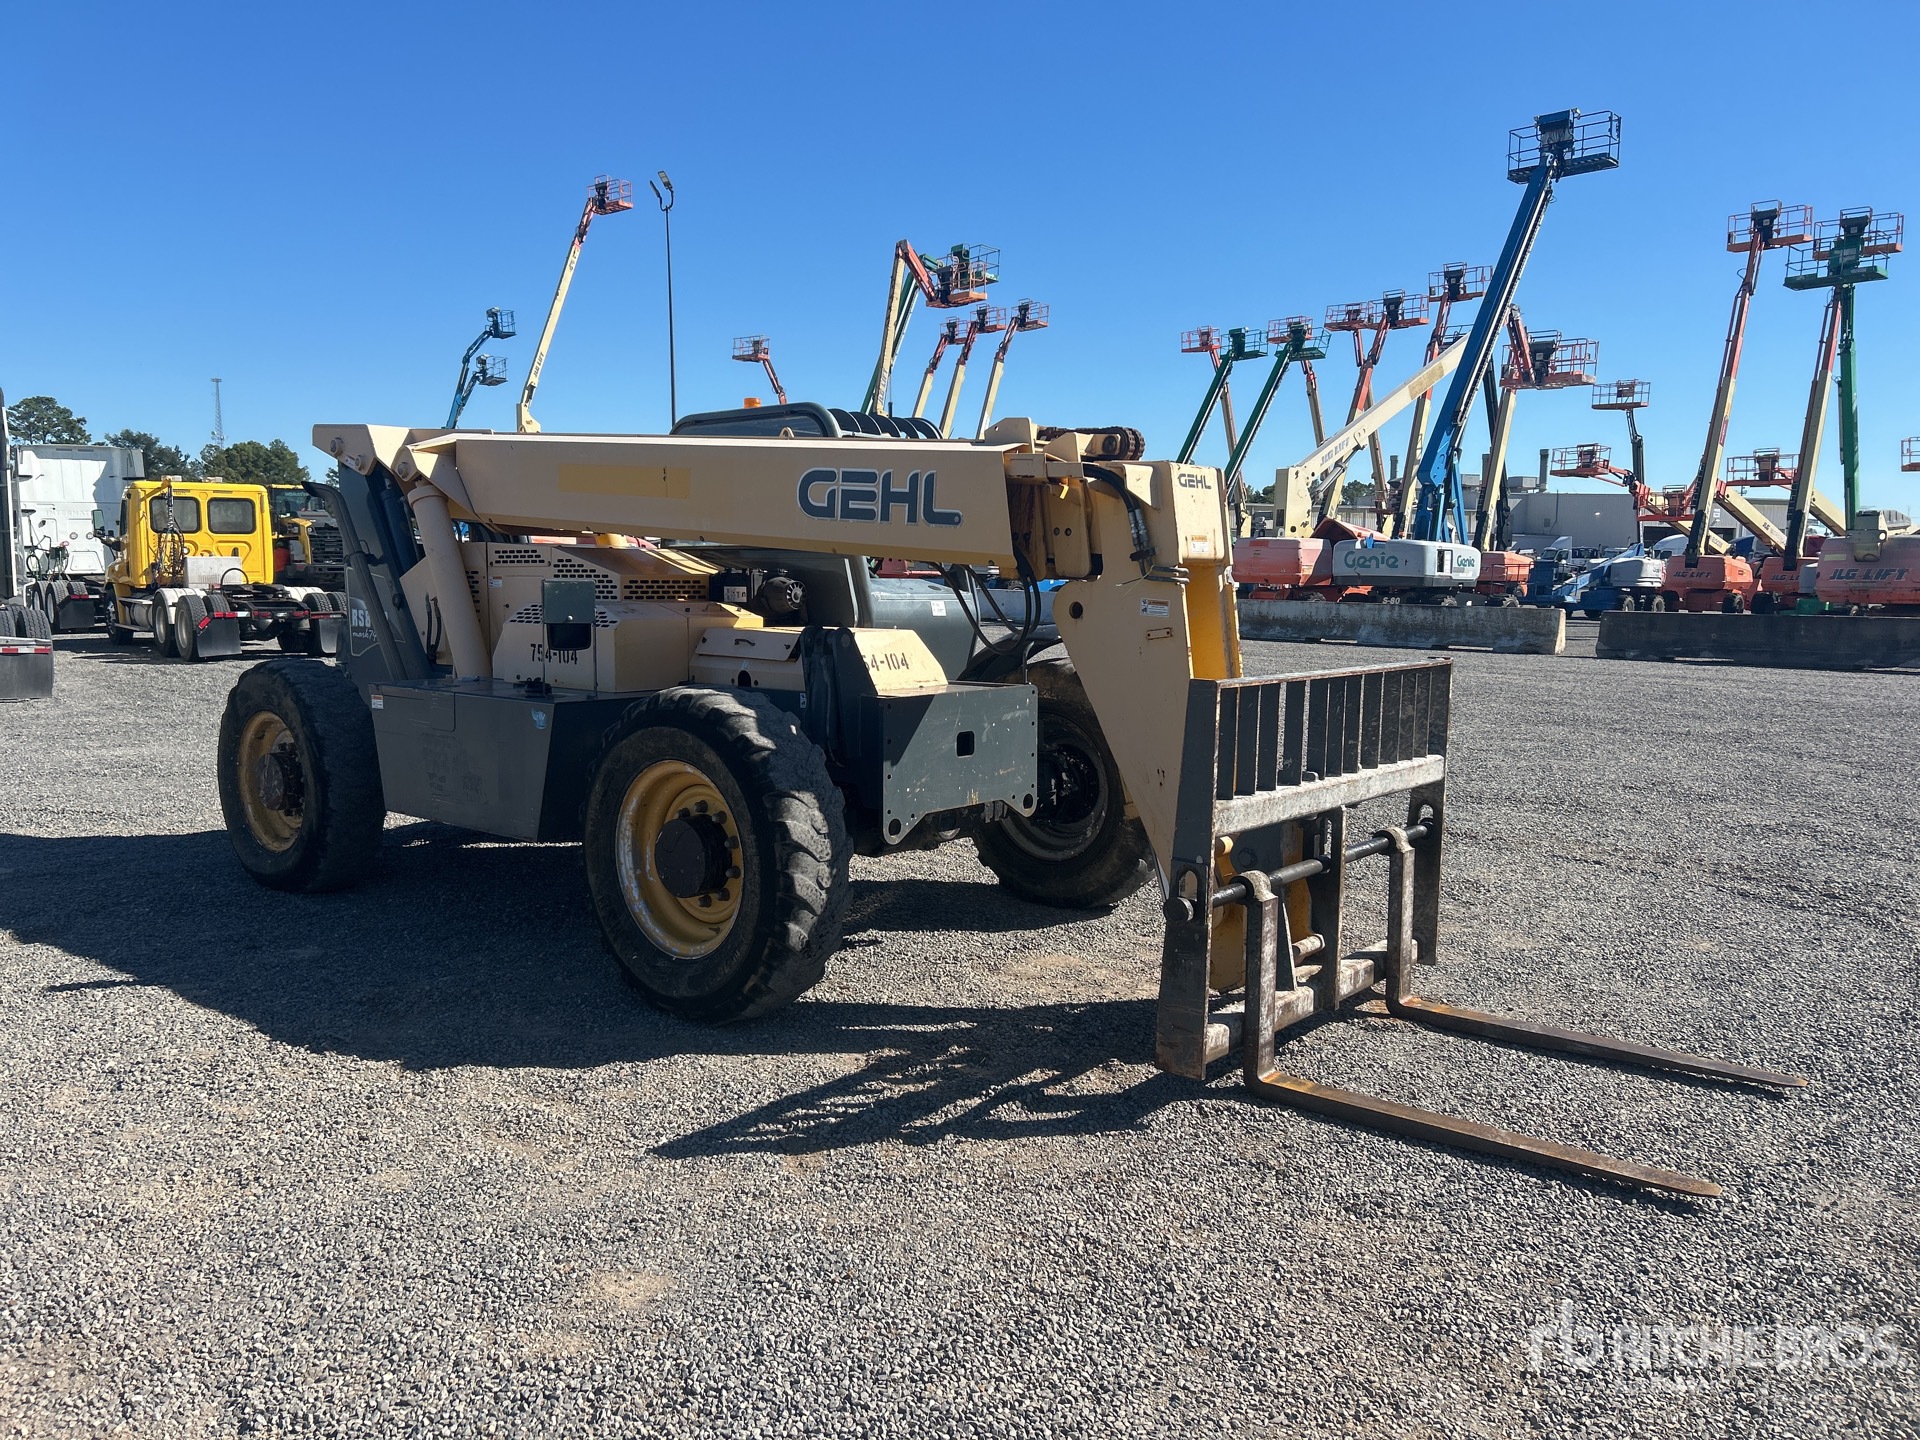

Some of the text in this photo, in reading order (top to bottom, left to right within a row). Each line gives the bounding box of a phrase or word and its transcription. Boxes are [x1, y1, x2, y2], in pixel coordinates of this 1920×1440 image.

[1320, 437, 1350, 467] JLG LIFT
[1177, 473, 1212, 490] GEHL
[797, 467, 963, 528] GEHL
[1343, 550, 1399, 569] Genie
[1456, 555, 1475, 568] Genie
[1829, 568, 1911, 581] JLG LIFT
[530, 643, 578, 665] 754-104
[861, 652, 910, 672] 54-104
